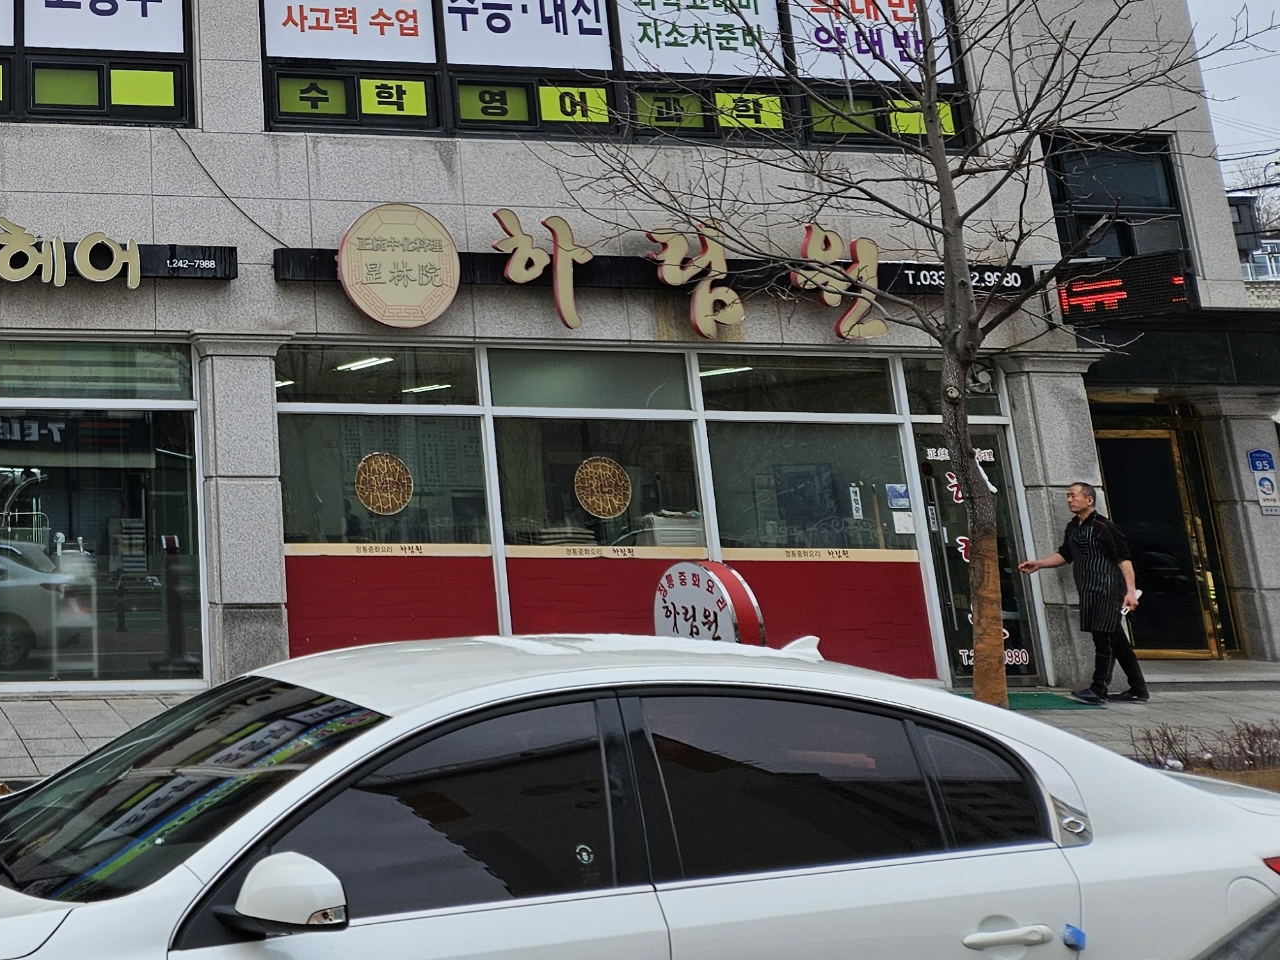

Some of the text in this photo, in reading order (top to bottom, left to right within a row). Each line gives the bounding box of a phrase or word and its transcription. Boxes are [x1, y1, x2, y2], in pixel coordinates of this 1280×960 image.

[282, 4, 419, 37] 사고력 수업
[638, 20, 764, 53] 자소서준비
[166, 258, 216, 269] t.242-7988
[1255, 460, 1270, 471] 95
[657, 571, 728, 613] 정통중화요리
[662, 597, 722, 641] 하림원
